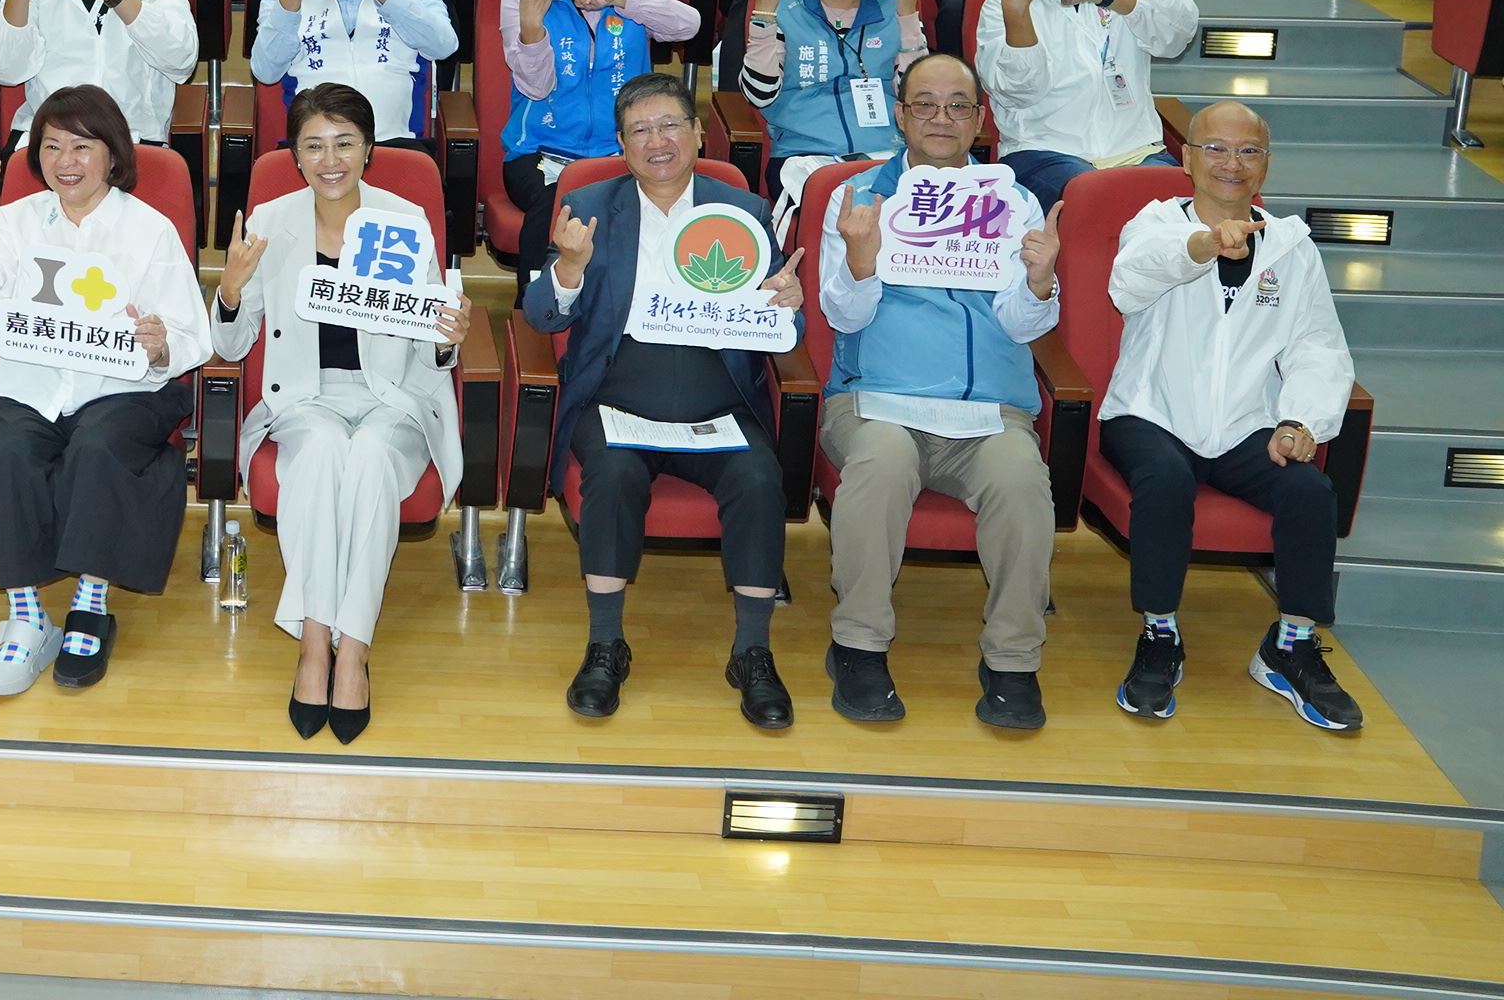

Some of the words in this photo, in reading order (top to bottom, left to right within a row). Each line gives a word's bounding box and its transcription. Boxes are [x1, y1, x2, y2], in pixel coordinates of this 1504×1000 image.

[559, 36, 577, 77] 行政處
[909, 178, 1005, 240] 彰化
[945, 239, 1001, 254] 縣政府
[890, 265, 931, 274] COUNTY
[932, 267, 1001, 279] GOVERNMENT
[891, 252, 1001, 271] CHANGHUA
[309, 277, 448, 317] 南投縣政府
[647, 293, 779, 327] 新竹縣政府
[308, 301, 342, 315] Nantou
[346, 307, 380, 323] County
[382, 312, 438, 330] Governmen
[5, 311, 137, 355] 嘉義市政府
[642, 321, 683, 335] HsinChu
[686, 325, 721, 340] County
[722, 329, 783, 341] Government
[5, 339, 39, 352] CHIAYI
[42, 344, 65, 355] CITY
[67, 348, 137, 368] GOVERNMENT
